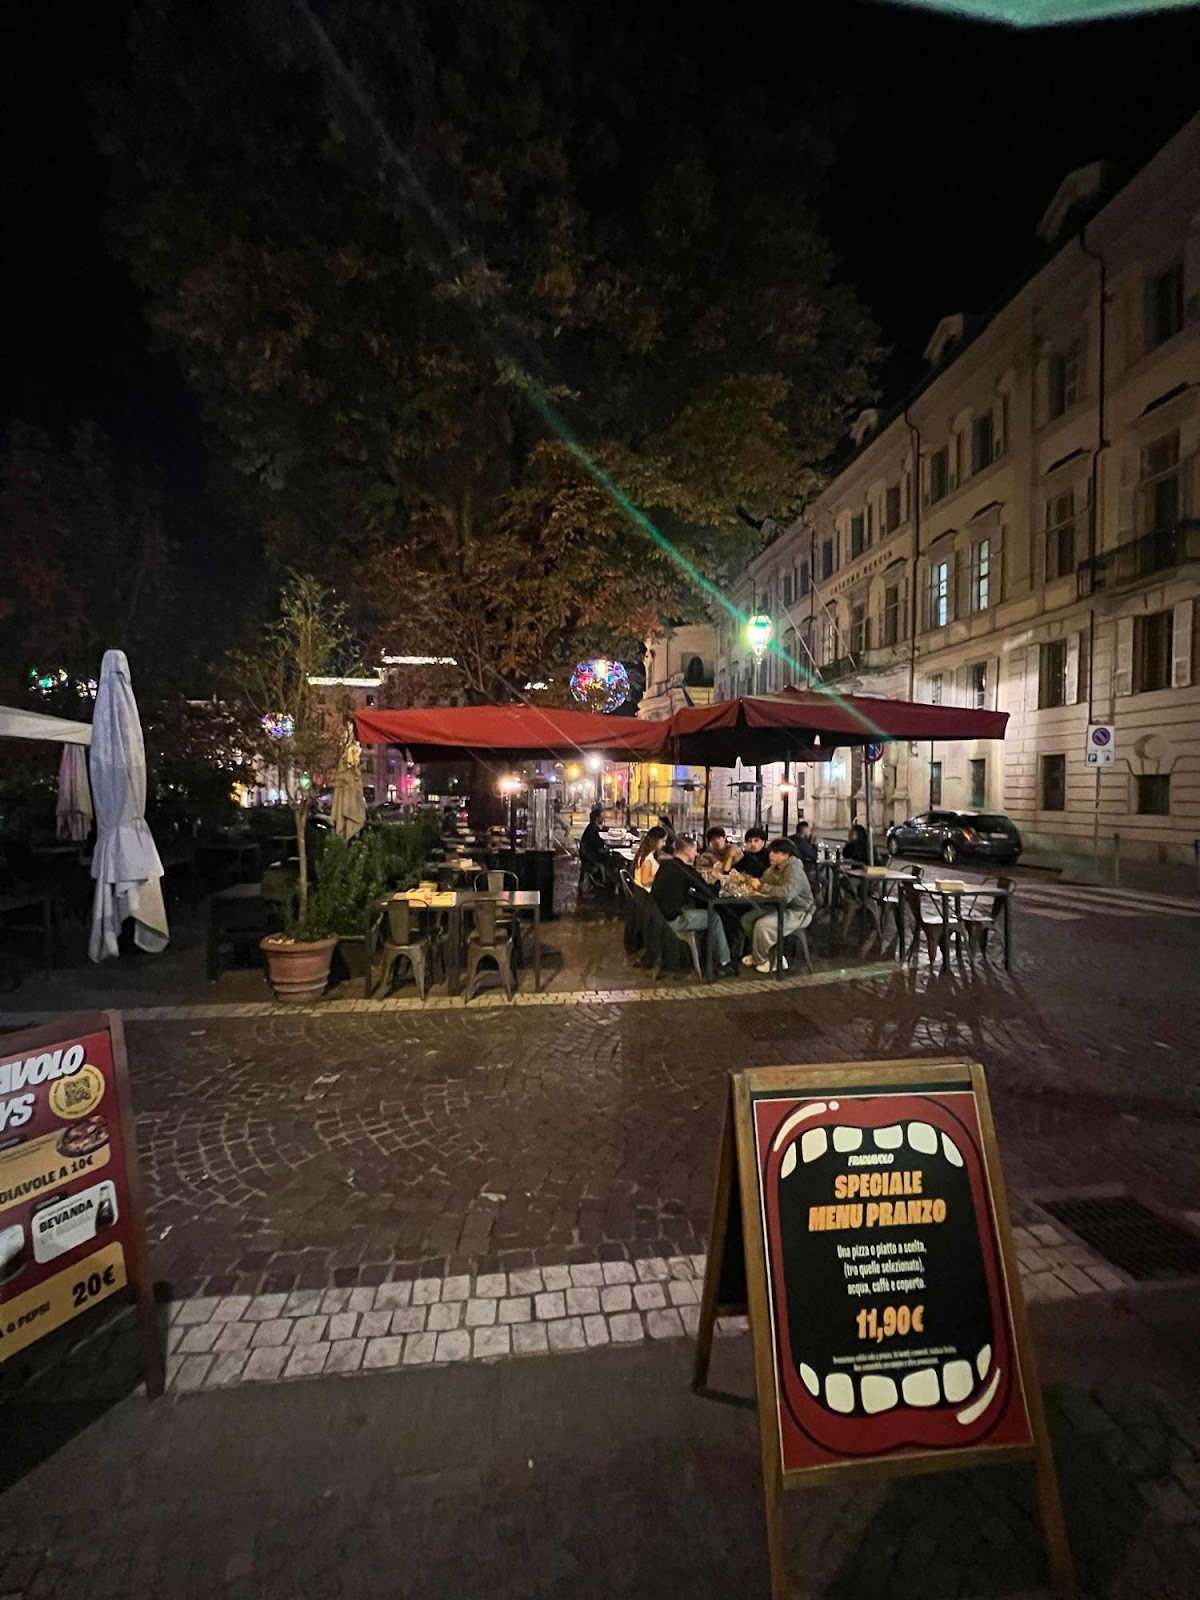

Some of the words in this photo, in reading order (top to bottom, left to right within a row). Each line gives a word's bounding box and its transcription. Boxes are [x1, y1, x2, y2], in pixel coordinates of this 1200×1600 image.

[59, 1166, 68, 1179] A
[71, 1154, 93, 1174] 10€
[835, 1170, 922, 1199] SPECIALE
[39, 1199, 94, 1233] BEVANDA
[808, 1203, 863, 1232] MENU
[866, 1198, 947, 1228] PRANZO
[837, 1244, 851, 1258] Una
[852, 1244, 870, 1261] pizza
[870, 1245, 875, 1255] o
[876, 1242, 897, 1259] piatto
[898, 1243, 903, 1253] a
[903, 1239, 928, 1253] scelta,
[844, 1262, 859, 1279] (tra
[859, 1260, 881, 1278] quelle
[72, 1264, 116, 1309] 20€
[847, 1283, 872, 1297] acqua,
[891, 1280, 896, 1291] e
[856, 1305, 925, 1344] 11,90€
